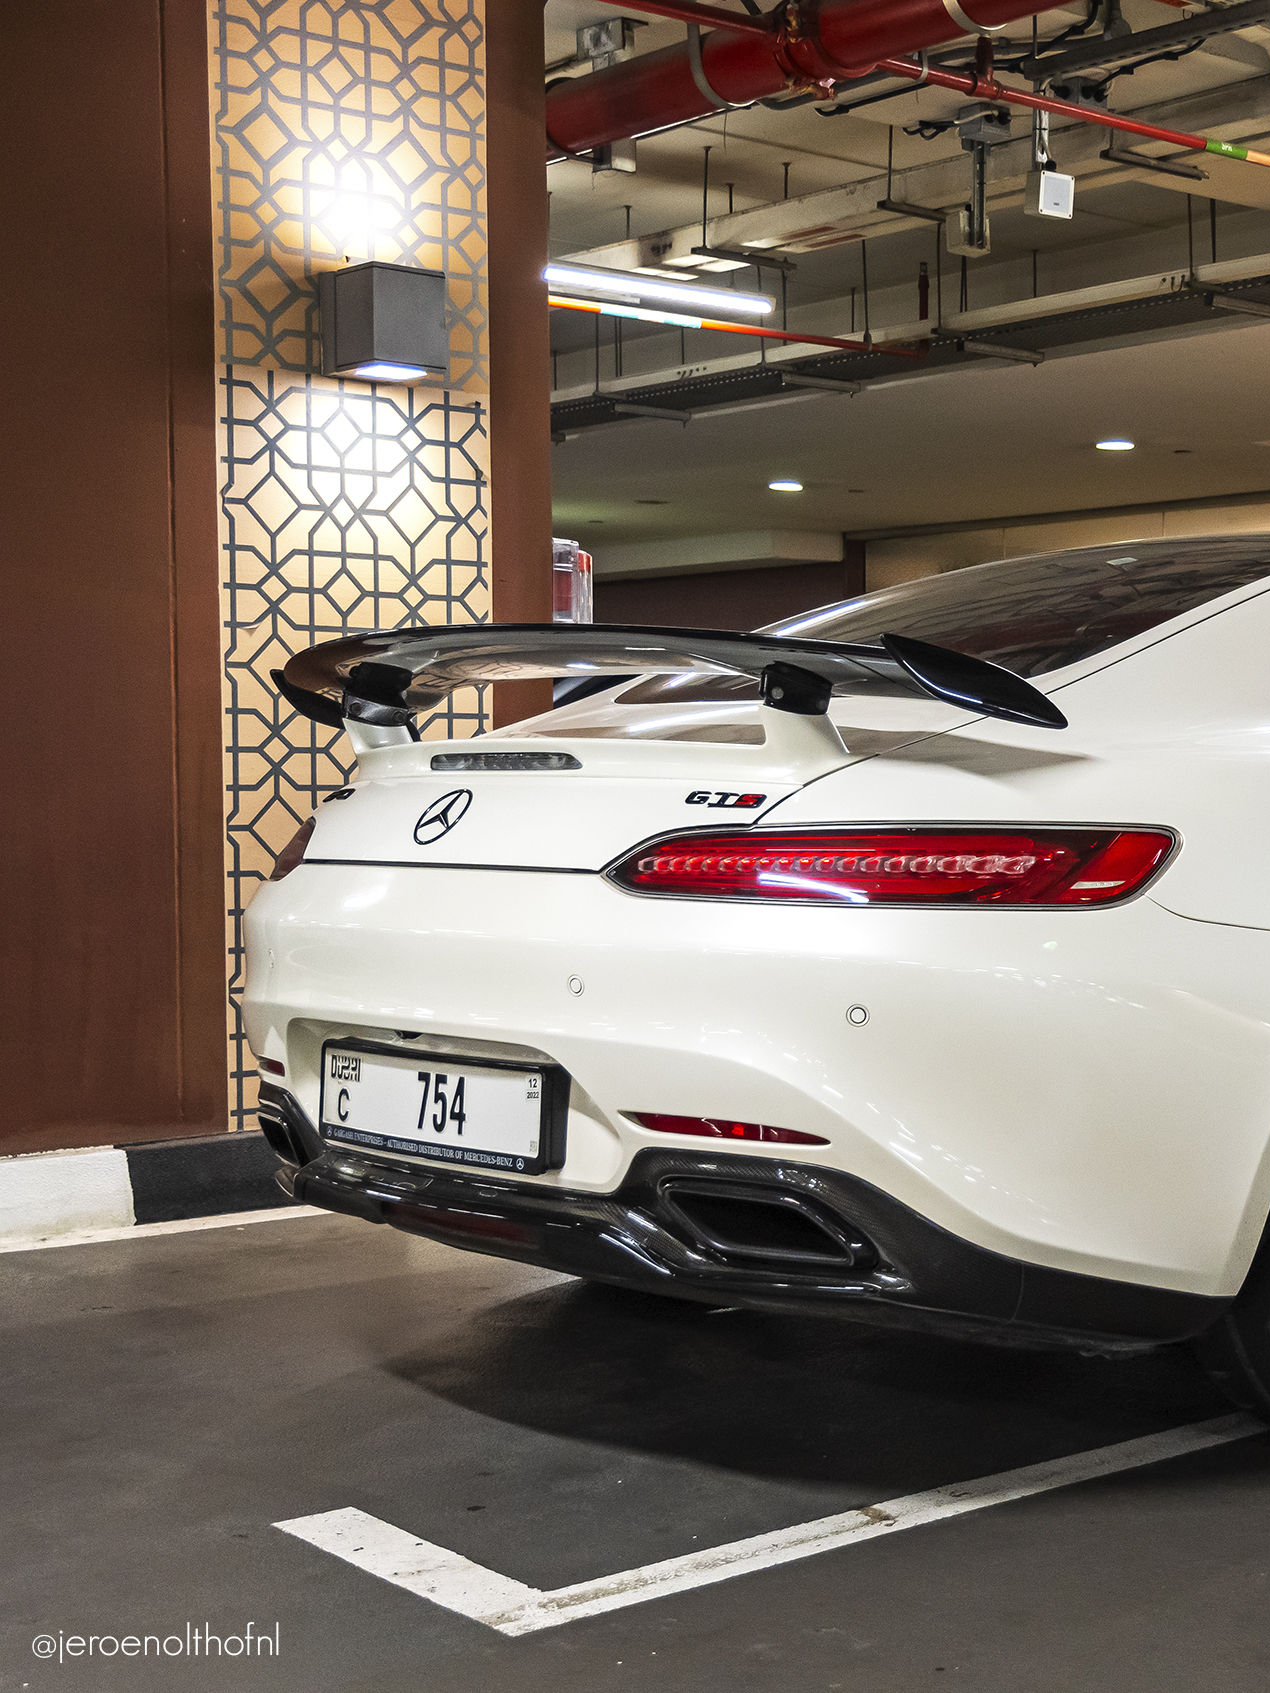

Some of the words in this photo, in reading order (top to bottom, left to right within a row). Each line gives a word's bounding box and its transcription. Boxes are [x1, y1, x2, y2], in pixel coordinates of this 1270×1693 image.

[527, 1091, 540, 1099] 2022
[529, 1078, 538, 1088] 12
[338, 1088, 350, 1122] C
[418, 1071, 466, 1135] 754
[354, 1132, 384, 1146] ENTERPRISES
[387, 1139, 418, 1152] AUTHORISED
[418, 1144, 454, 1158] DISTRIBUTOR
[455, 1150, 463, 1159] OF
[464, 1151, 513, 1167] MERCEDES-BENZ
